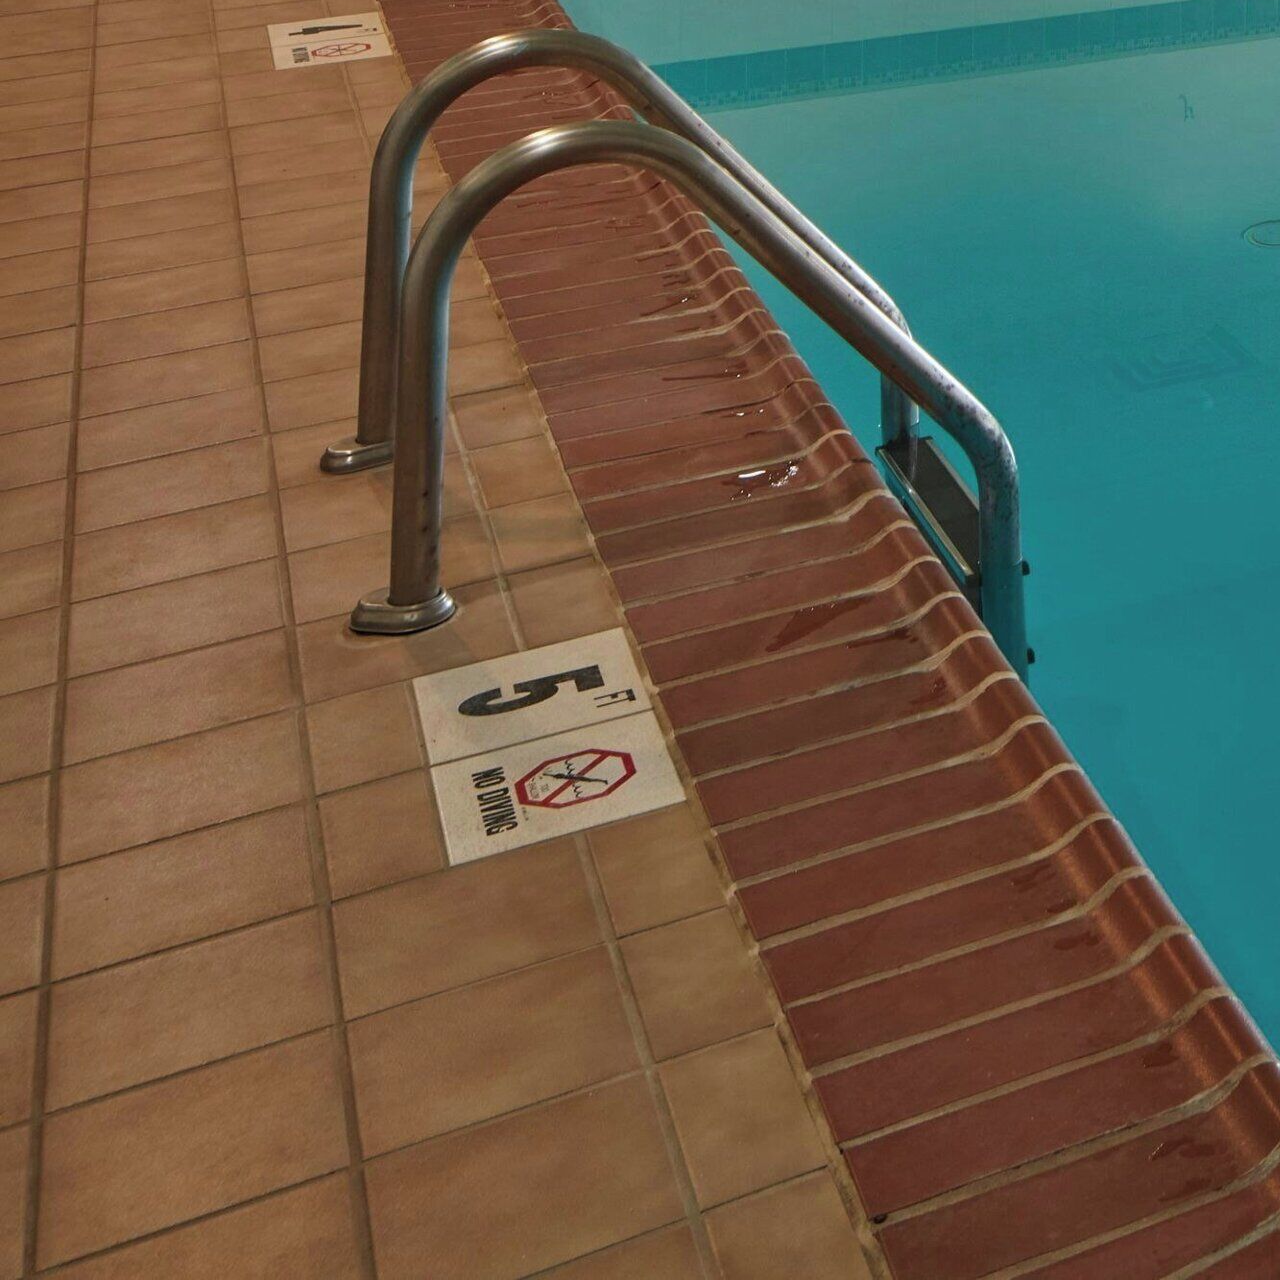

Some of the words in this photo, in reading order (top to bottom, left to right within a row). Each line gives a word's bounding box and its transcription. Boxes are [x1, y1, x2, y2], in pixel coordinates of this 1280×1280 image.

[458, 664, 605, 717] 5
[593, 688, 636, 708] FT
[471, 766, 506, 789] NO
[477, 787, 518, 836] DIVING
